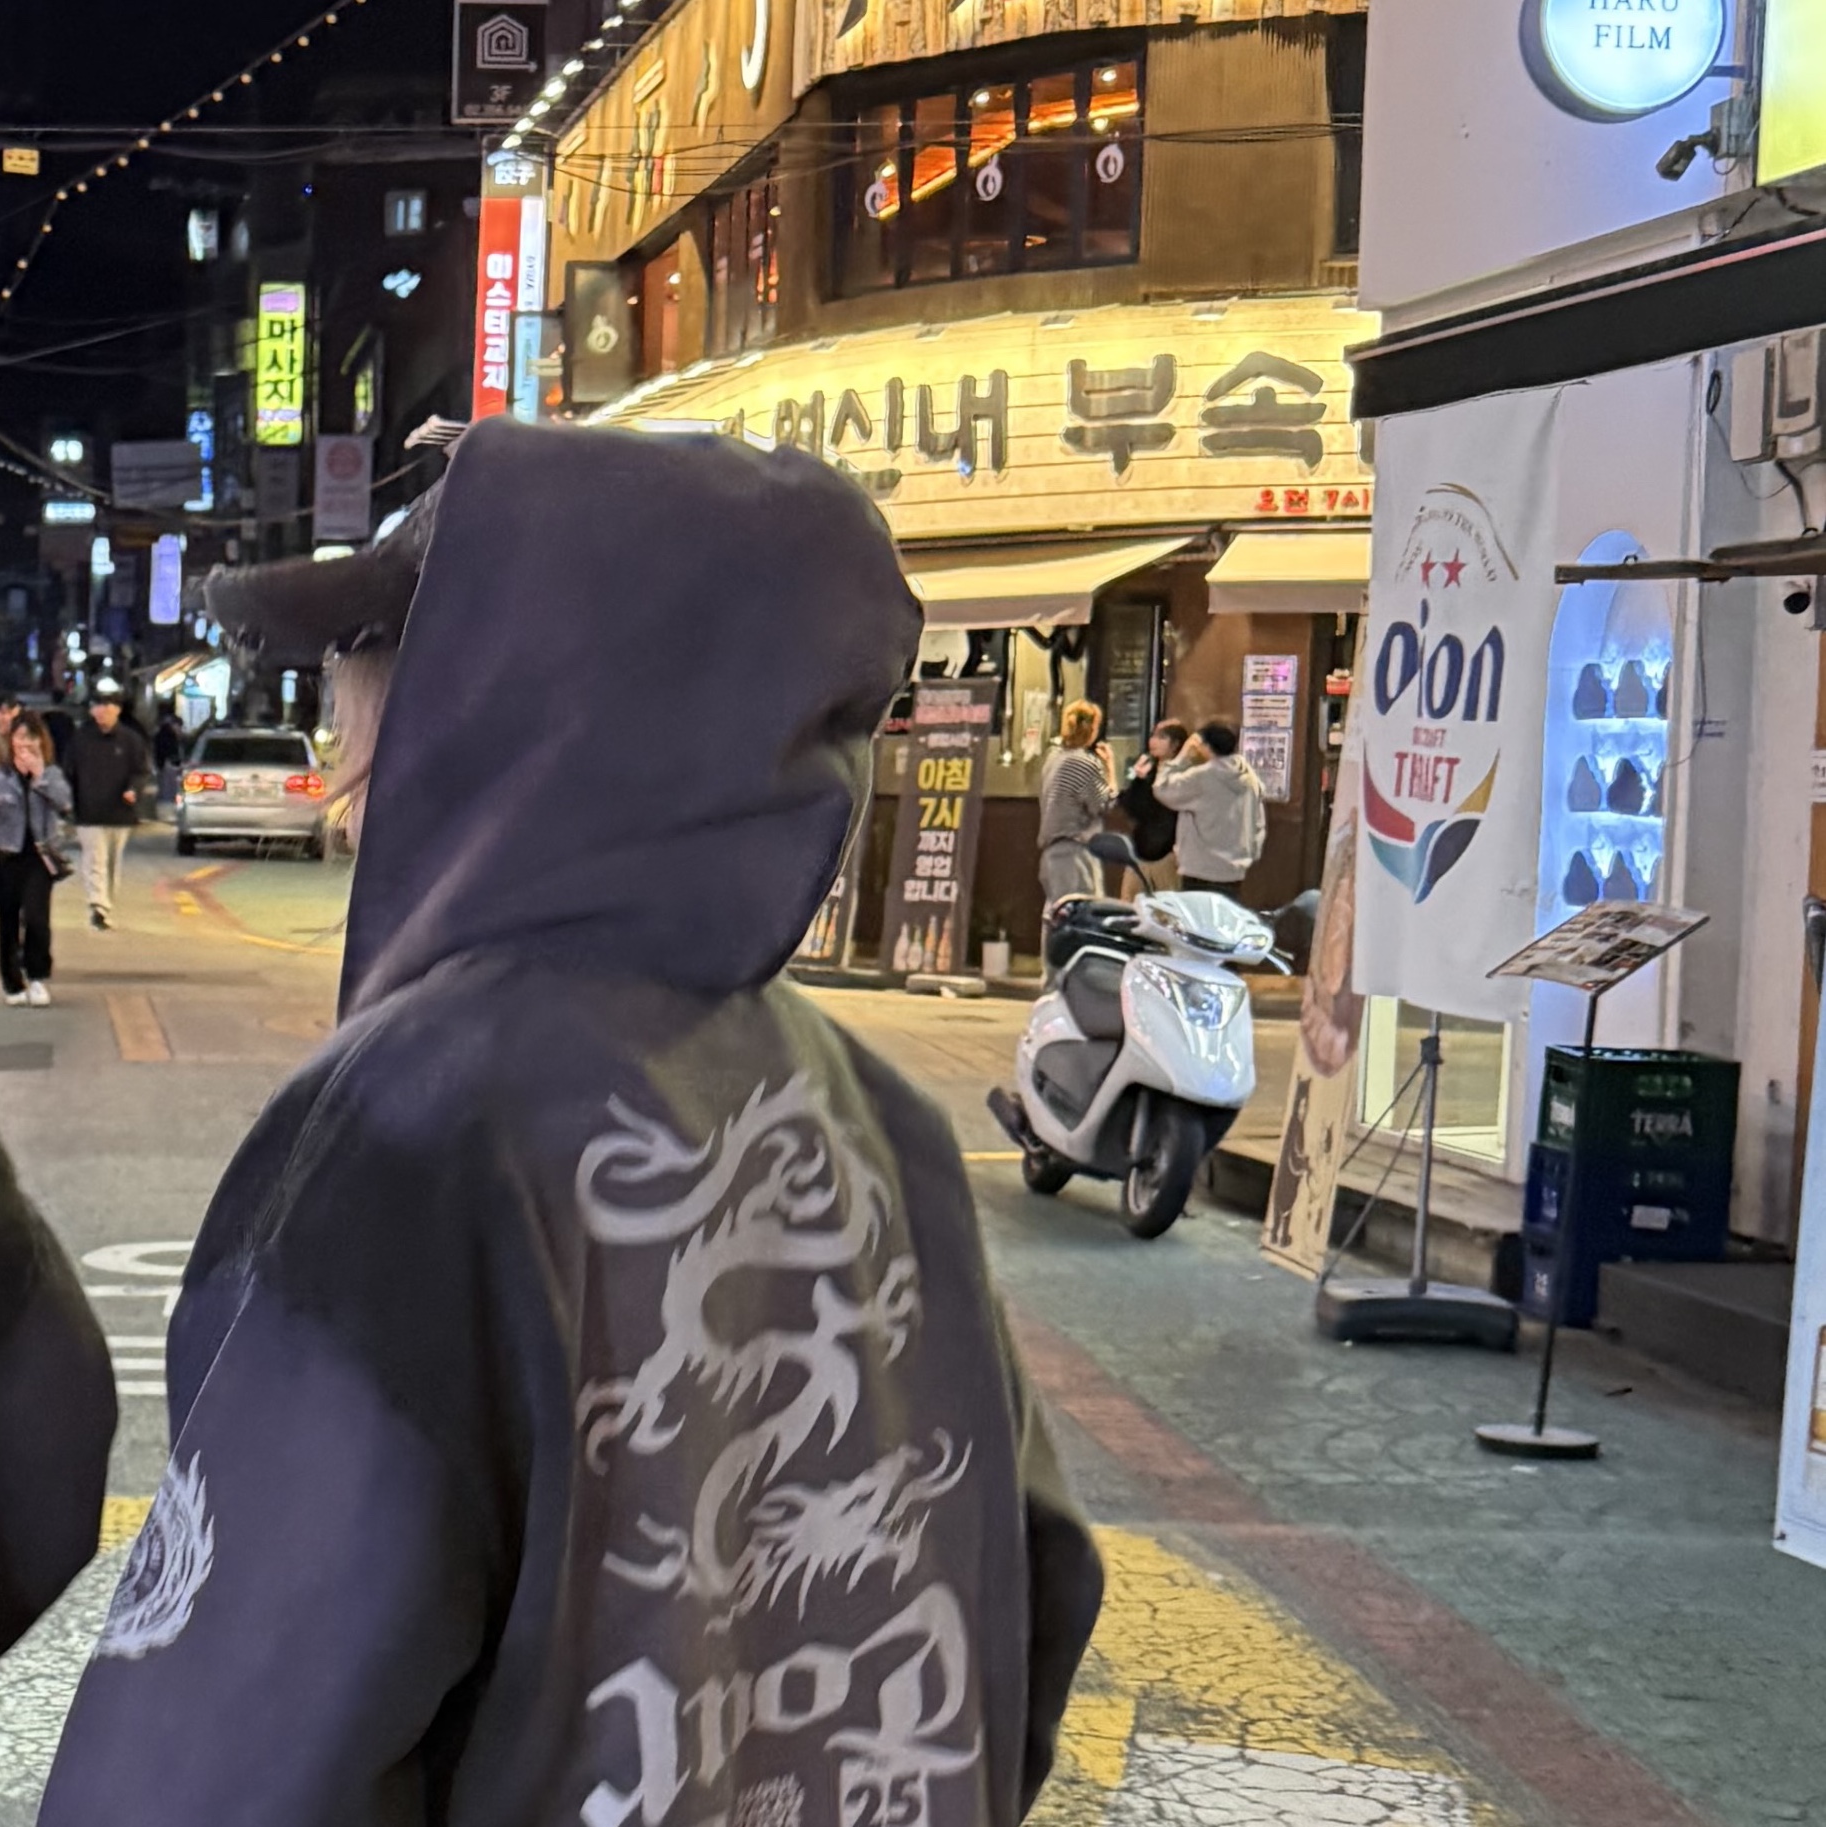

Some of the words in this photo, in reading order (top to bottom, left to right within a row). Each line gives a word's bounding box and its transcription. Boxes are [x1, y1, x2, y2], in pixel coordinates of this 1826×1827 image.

[1594, 23, 1673, 50] FILM
[481, 253, 514, 391] 미스터교자
[265, 319, 297, 405] 마사지
[1061, 352, 1374, 477] 부속
[917, 758, 973, 791] 아침
[918, 797, 964, 829] 7시
[917, 831, 955, 853] 까지
[915, 855, 952, 877] 영업
[903, 880, 958, 902] 합니다
[1630, 1108, 1693, 1137] TERRA
